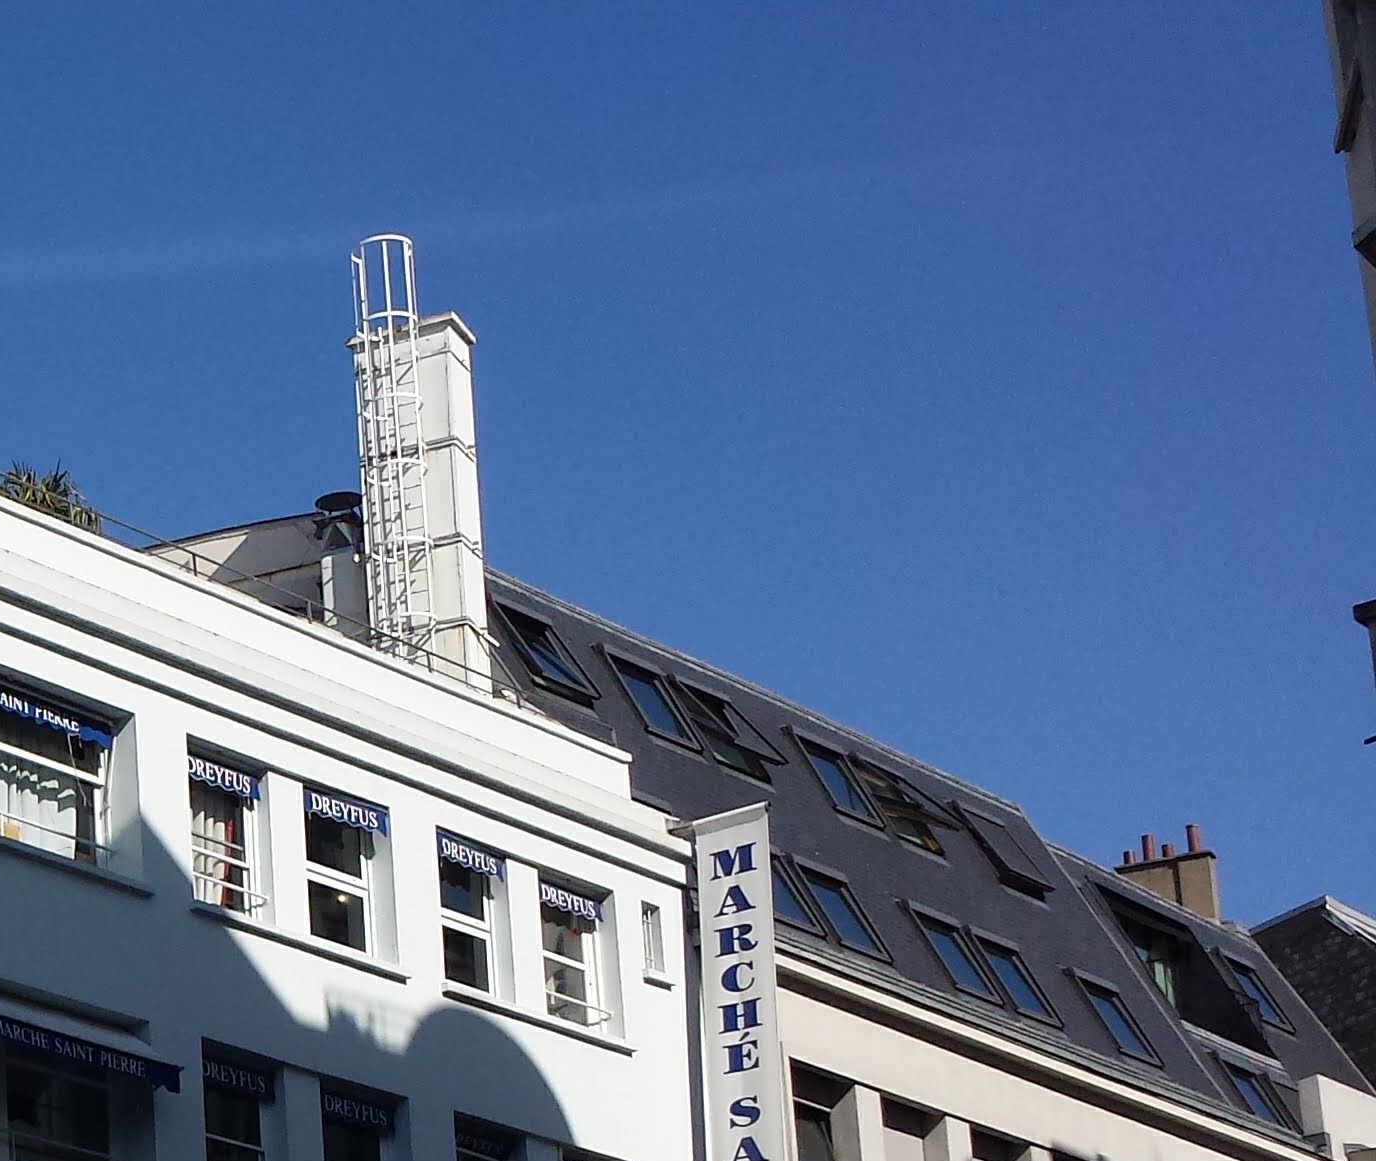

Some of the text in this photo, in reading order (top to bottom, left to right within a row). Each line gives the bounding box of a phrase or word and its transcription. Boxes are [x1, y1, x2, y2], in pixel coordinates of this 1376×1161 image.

[35, 703, 80, 732] PIERRE
[188, 757, 252, 795] DREYFUS
[311, 793, 379, 829] DREYFUS
[442, 838, 497, 876] DREYFUS
[541, 884, 596, 919] DREYFUS
[709, 841, 762, 1075] MARCHÉ
[54, 1035, 96, 1065] SAINT
[99, 1050, 147, 1079] PIERRE
[203, 1060, 265, 1093] DREYFUS
[324, 1094, 387, 1127] DREYFUS
